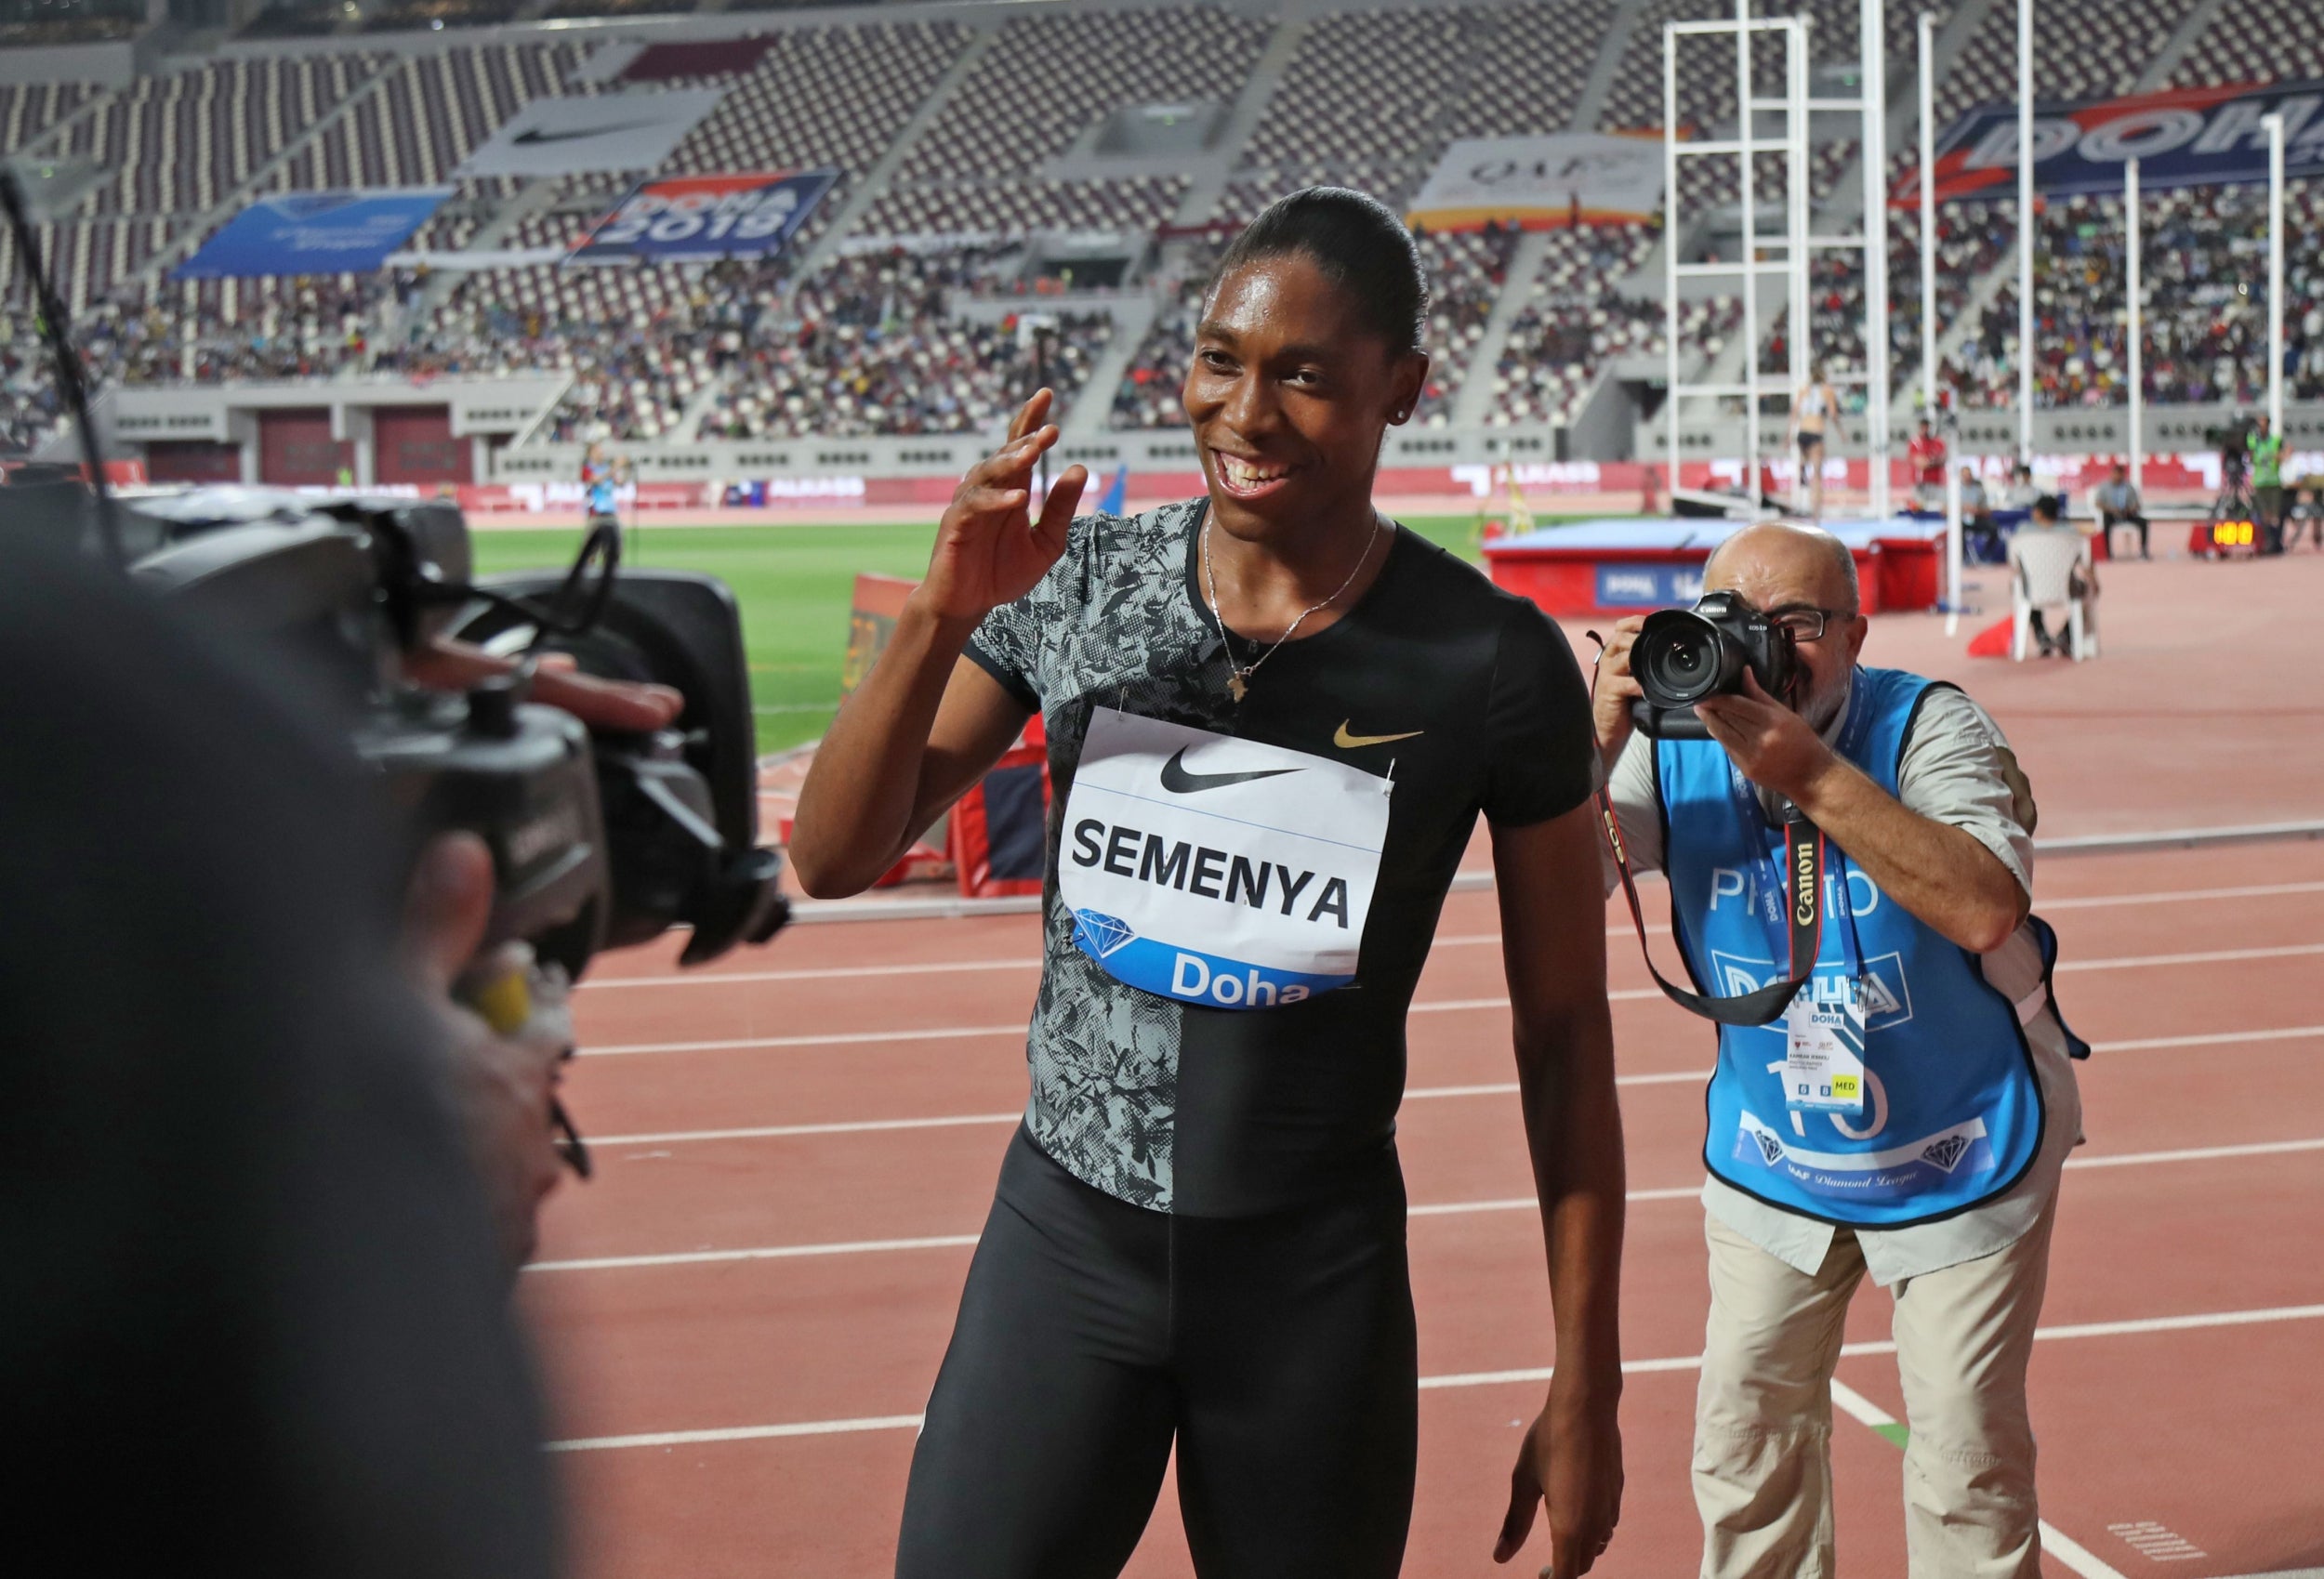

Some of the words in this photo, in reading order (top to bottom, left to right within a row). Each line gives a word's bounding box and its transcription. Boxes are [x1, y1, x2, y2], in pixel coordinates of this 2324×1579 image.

[1604, 809, 1625, 863] EOS
[1072, 819, 1349, 929] SEMENYA
[1797, 843, 1815, 926] Canon
[1764, 891, 1778, 922] DOHA
[1170, 952, 1310, 1007] Doha
[1812, 1014, 1842, 1023] DOHA
[1800, 1085, 1807, 1094] 6
[1835, 1081, 1855, 1091] MED
[1816, 1174, 1871, 1189] Diamond
[1875, 1170, 1918, 1187] League
